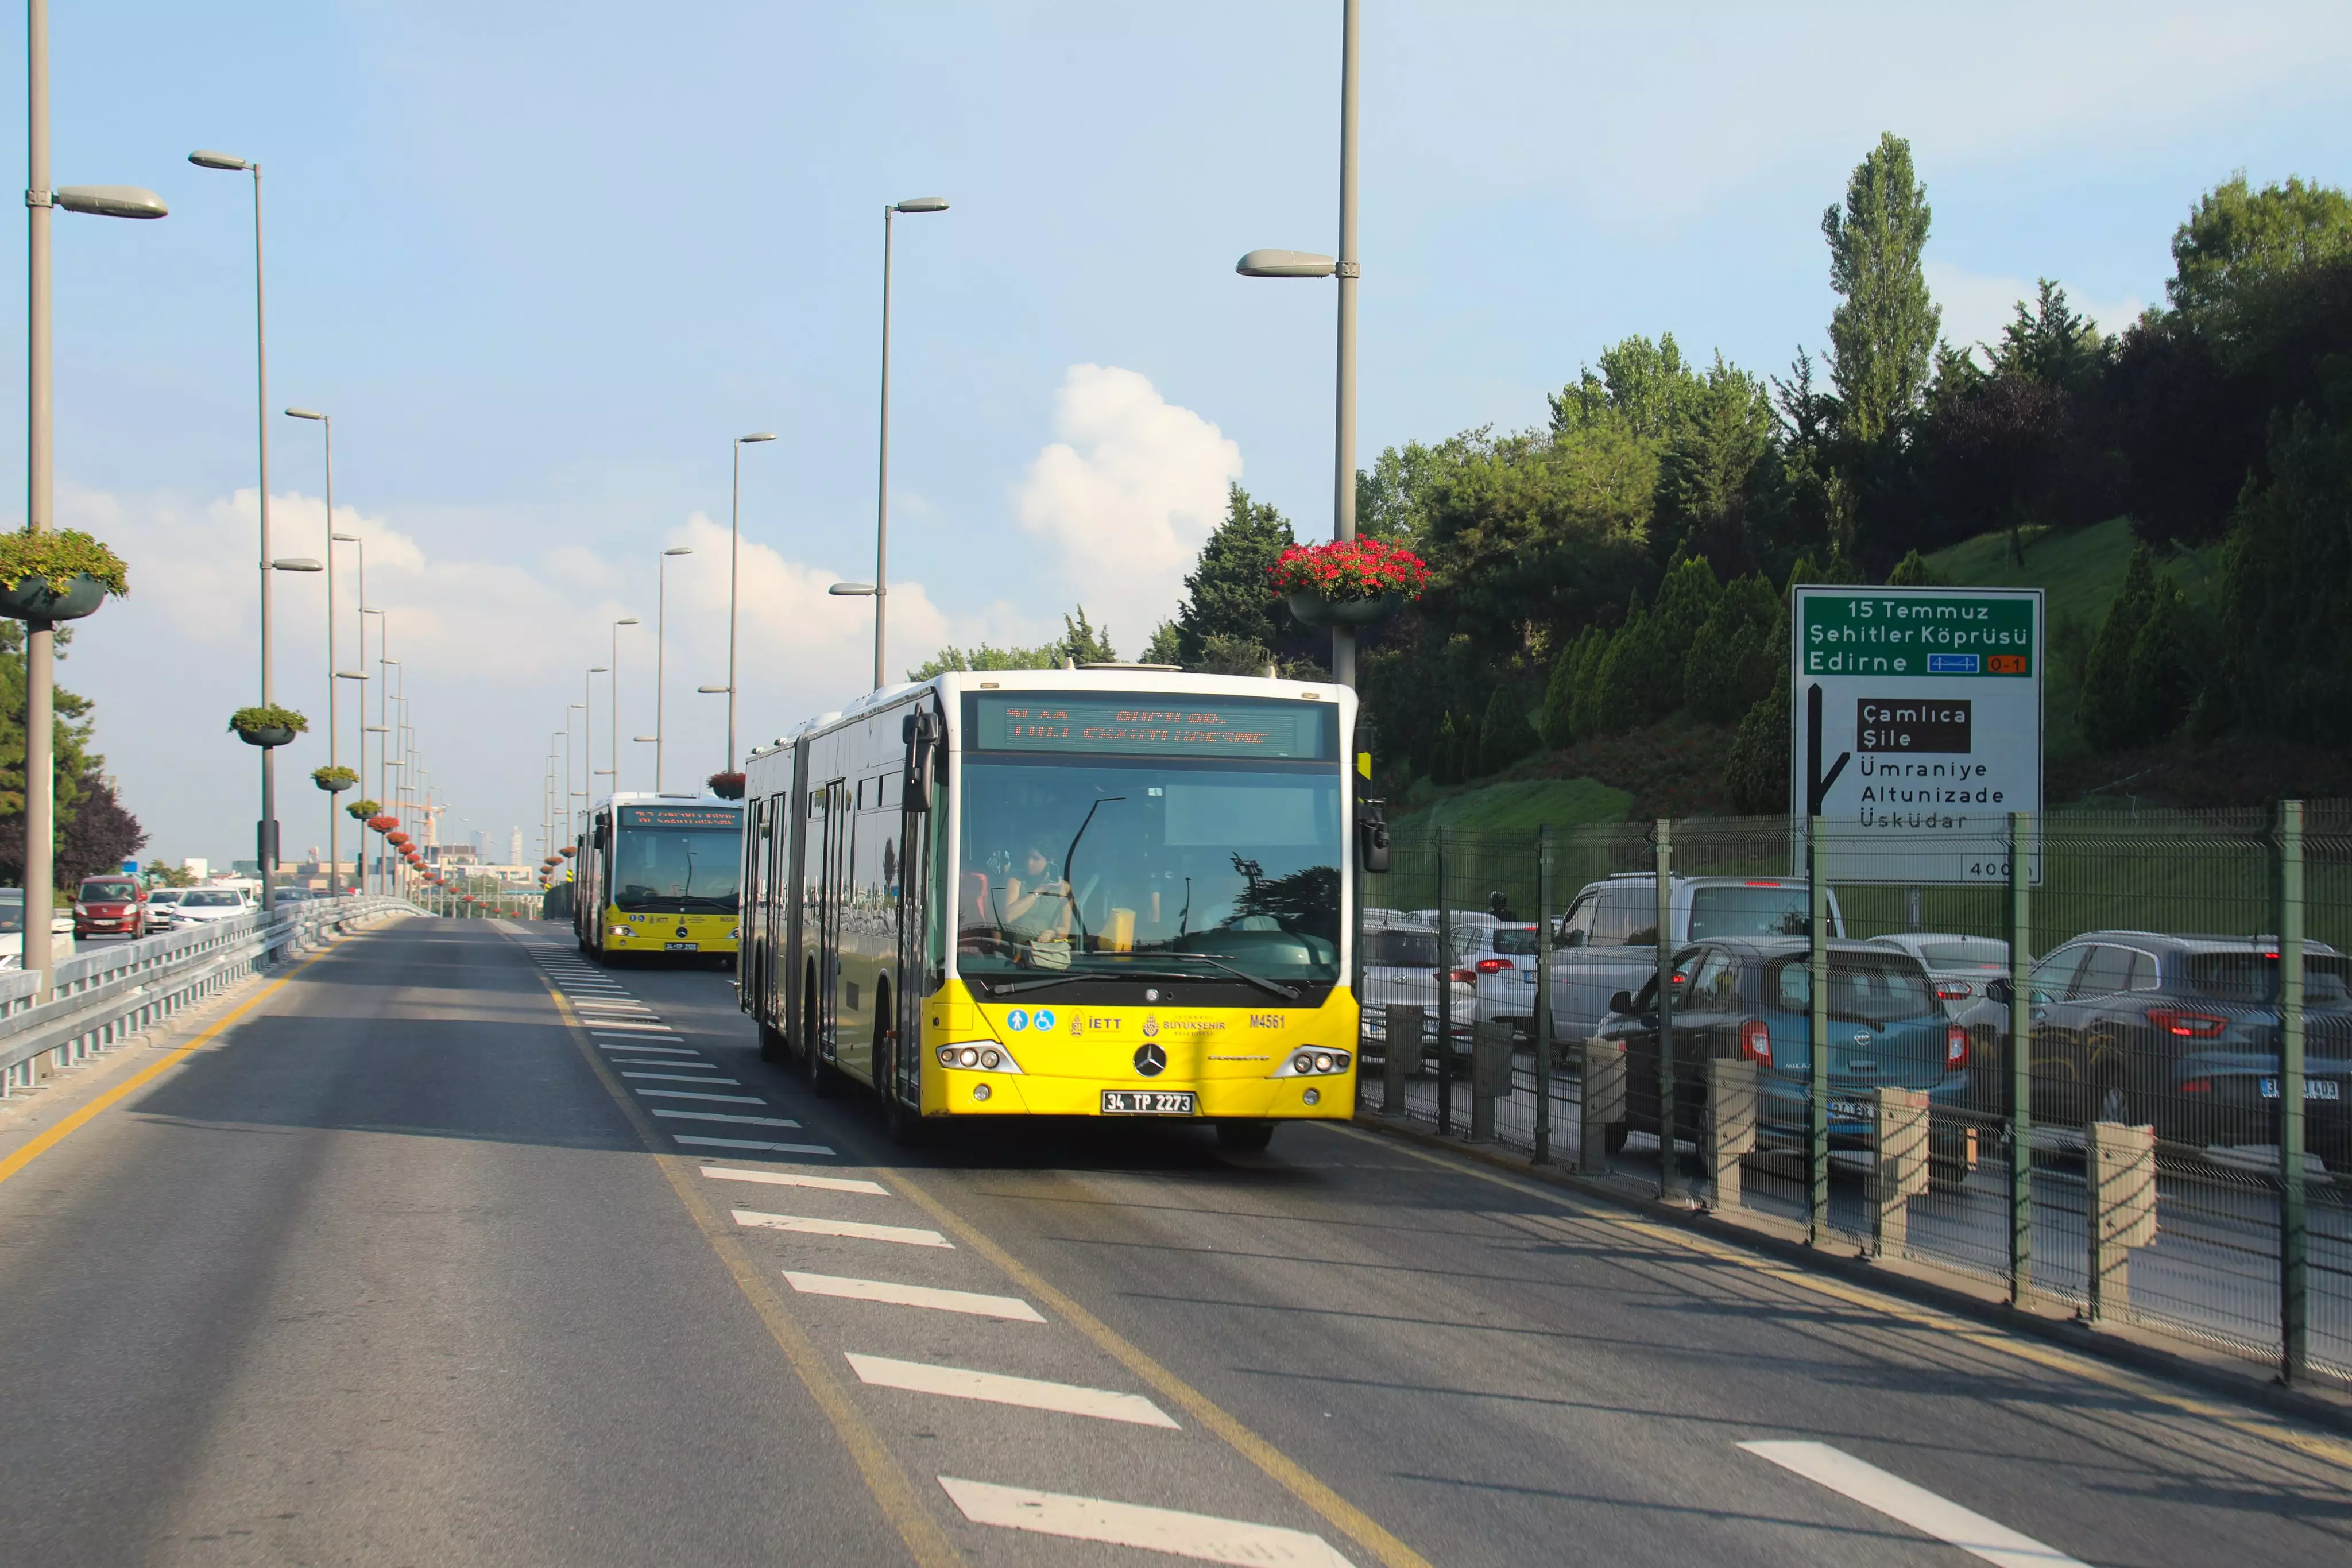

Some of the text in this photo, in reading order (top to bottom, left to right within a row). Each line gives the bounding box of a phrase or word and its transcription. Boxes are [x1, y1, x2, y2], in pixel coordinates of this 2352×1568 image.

[1848, 601, 1989, 620] 15 Temmuz
[1810, 624, 2027, 648] Şehitler Köprüsü
[1810, 651, 1907, 671] Edirne
[1863, 705, 1966, 724] Çamlıca
[1863, 729, 1911, 748] Şile
[1860, 756, 1987, 781] Ümraniye
[1861, 786, 2004, 803] Altunizade
[1860, 807, 1967, 828] Üsküdar
[1970, 862, 2010, 876] 400
[1089, 1016, 1121, 1029] İETT
[1250, 1015, 1285, 1028] M4561
[1108, 1094, 1190, 1112] 34 TP 2273
